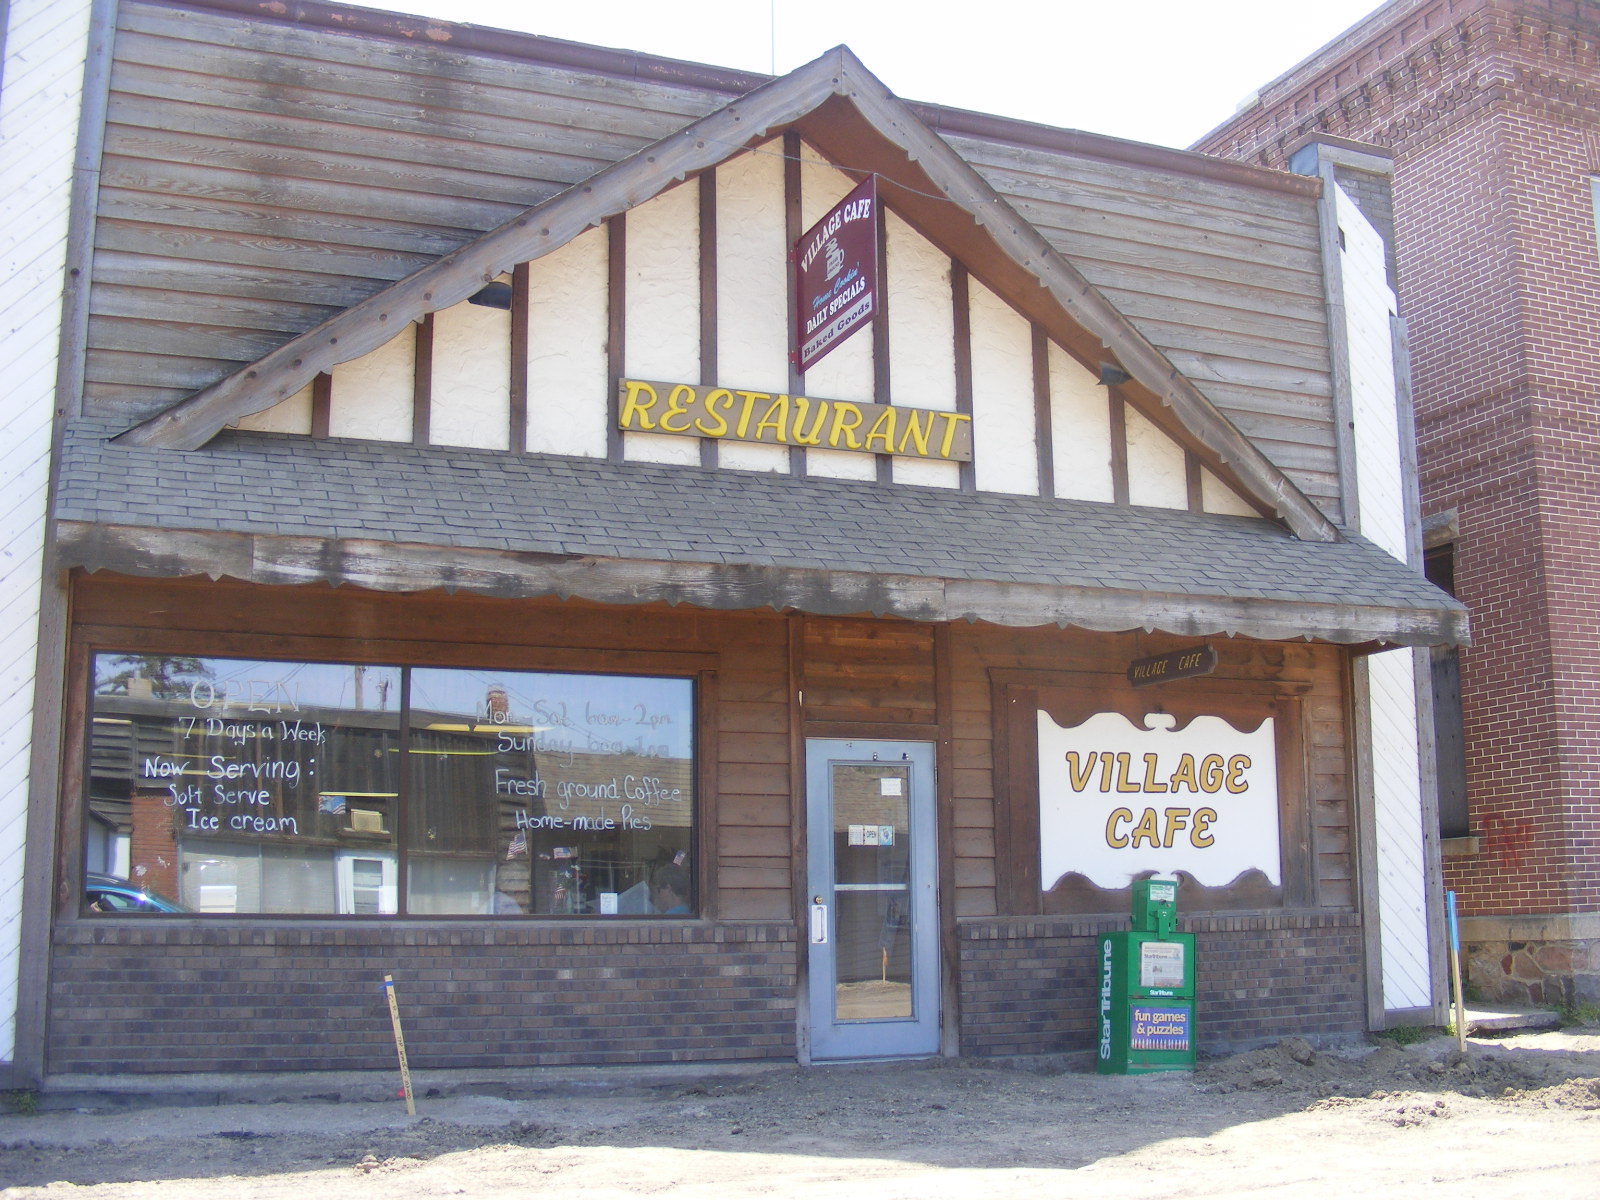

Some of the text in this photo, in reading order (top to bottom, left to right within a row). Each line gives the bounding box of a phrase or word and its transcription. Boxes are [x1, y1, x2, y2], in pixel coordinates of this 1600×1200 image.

[801, 198, 871, 273] VILLAGE CAFE
[806, 276, 866, 334] DAILY SPECIALS
[803, 301, 870, 358] Baked Goods
[620, 380, 971, 458] RESTAURANT
[1133, 652, 1202, 679] VILLAGE CAFE
[190, 679, 301, 715] OPEN
[178, 716, 327, 746] 7 Days a Week
[498, 730, 573, 768] Sunday
[145, 755, 191, 778] Now
[1065, 751, 1252, 794] VILLAGE
[164, 783, 270, 806] Soft Serve
[495, 768, 682, 809] Fresh ground Coffee
[186, 808, 298, 834] Ice cream
[621, 803, 652, 831] Pies
[1105, 807, 1218, 850] CAFE
[1134, 1009, 1186, 1024] fun games
[1136, 1022, 1184, 1036] & puzzles
